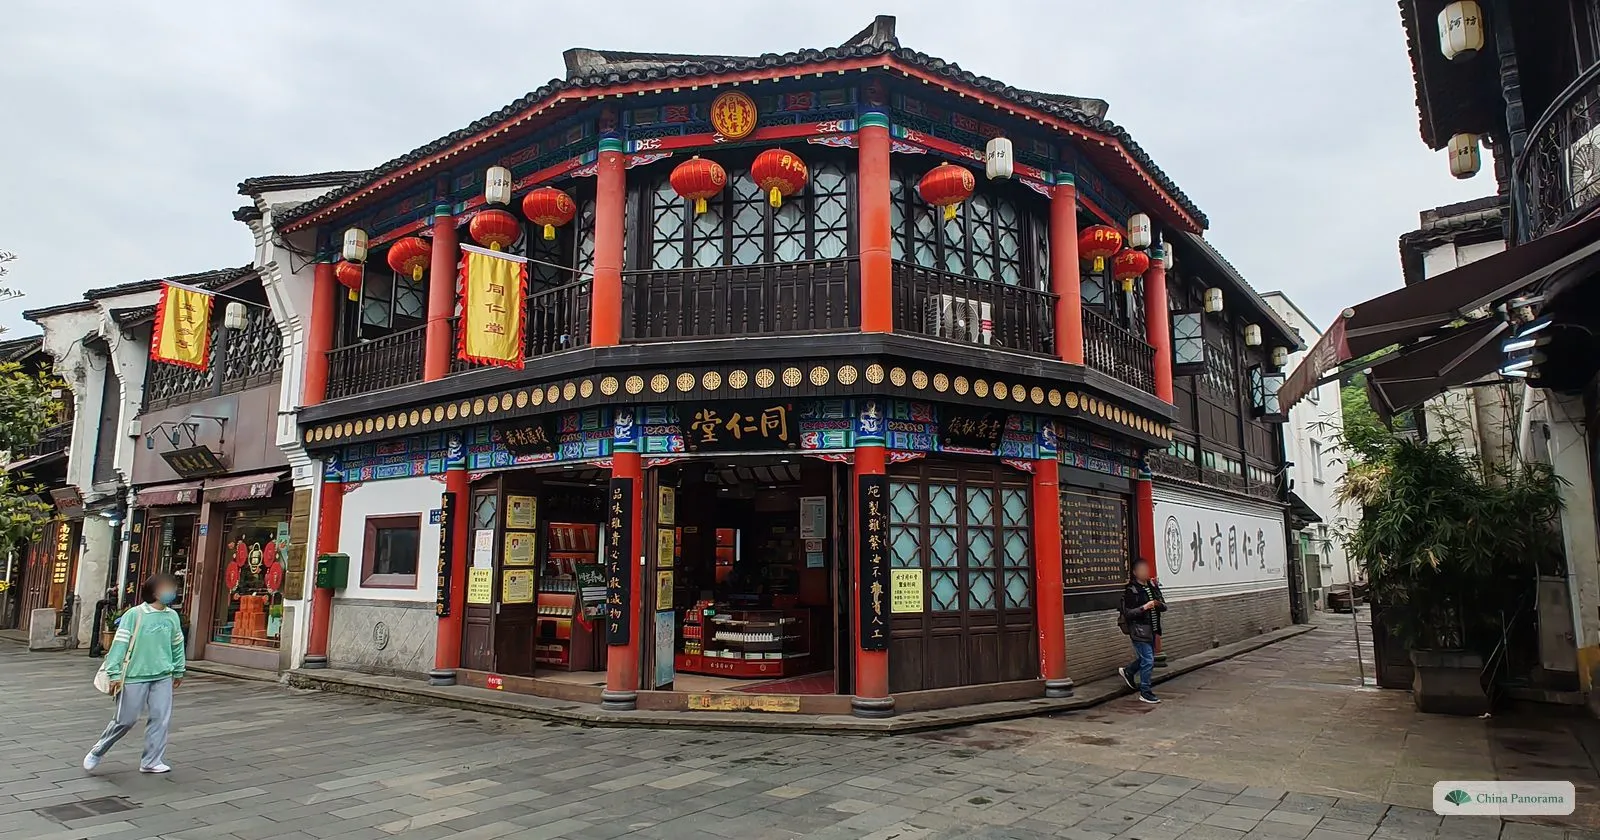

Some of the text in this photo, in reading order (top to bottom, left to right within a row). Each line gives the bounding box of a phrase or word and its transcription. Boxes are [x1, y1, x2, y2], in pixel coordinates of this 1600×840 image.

[727, 100, 739, 134] 同仁堂
[483, 282, 507, 336] 同仁堂
[1190, 521, 1266, 573] 北京同仁堂
